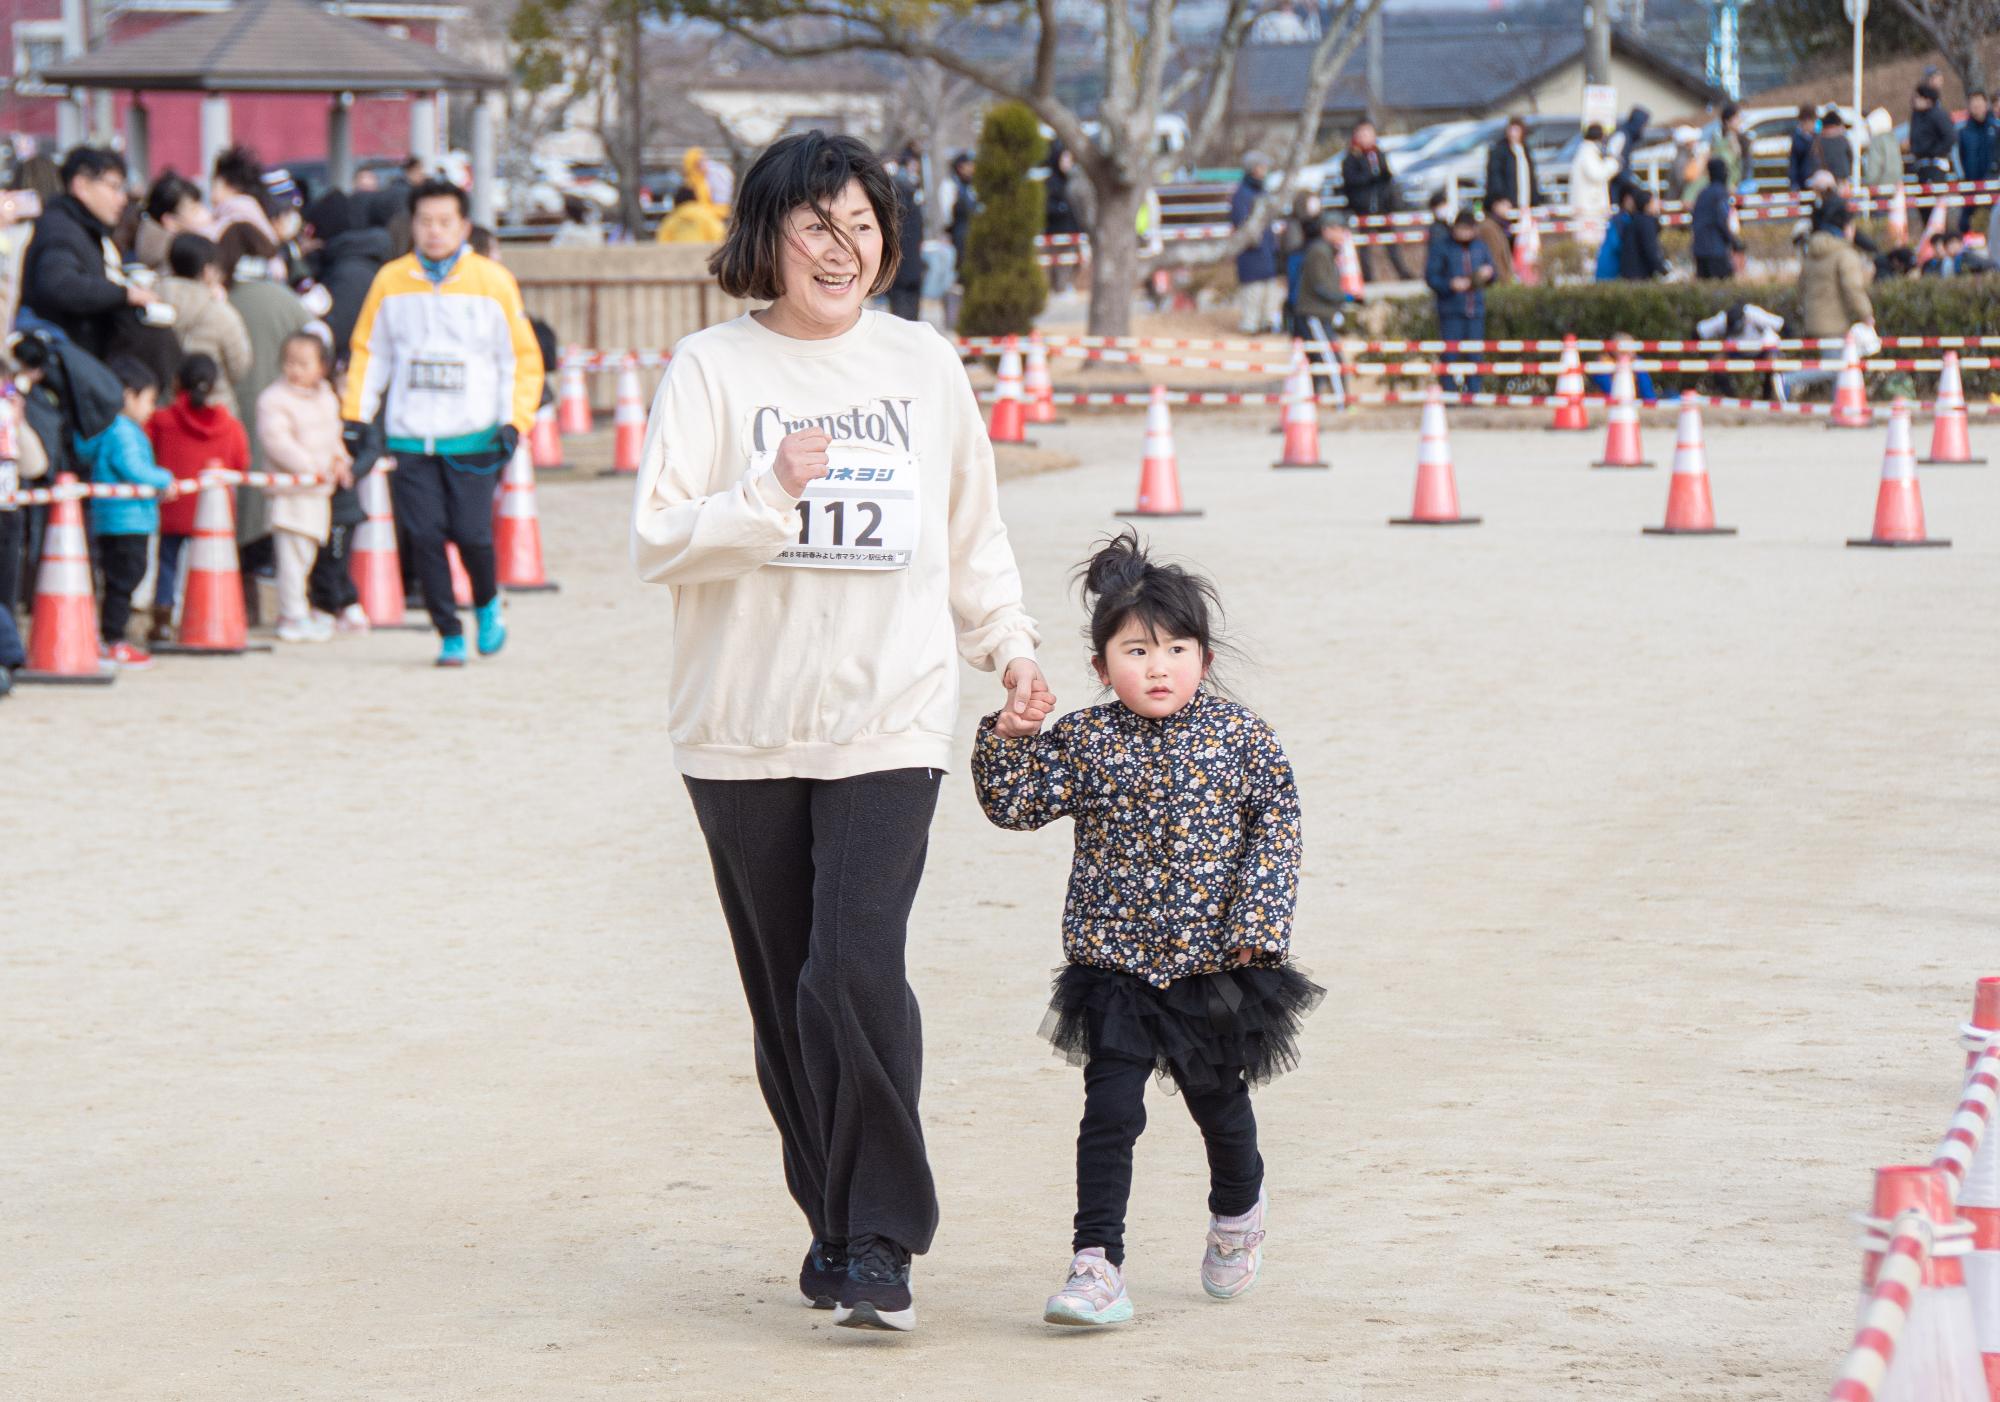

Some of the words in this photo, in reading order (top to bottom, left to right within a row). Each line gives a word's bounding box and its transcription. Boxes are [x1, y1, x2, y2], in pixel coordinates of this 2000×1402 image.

[795, 500, 883, 547] 112
[776, 550, 894, 561] 和8年新春みよし市マラソン駅伝大会
